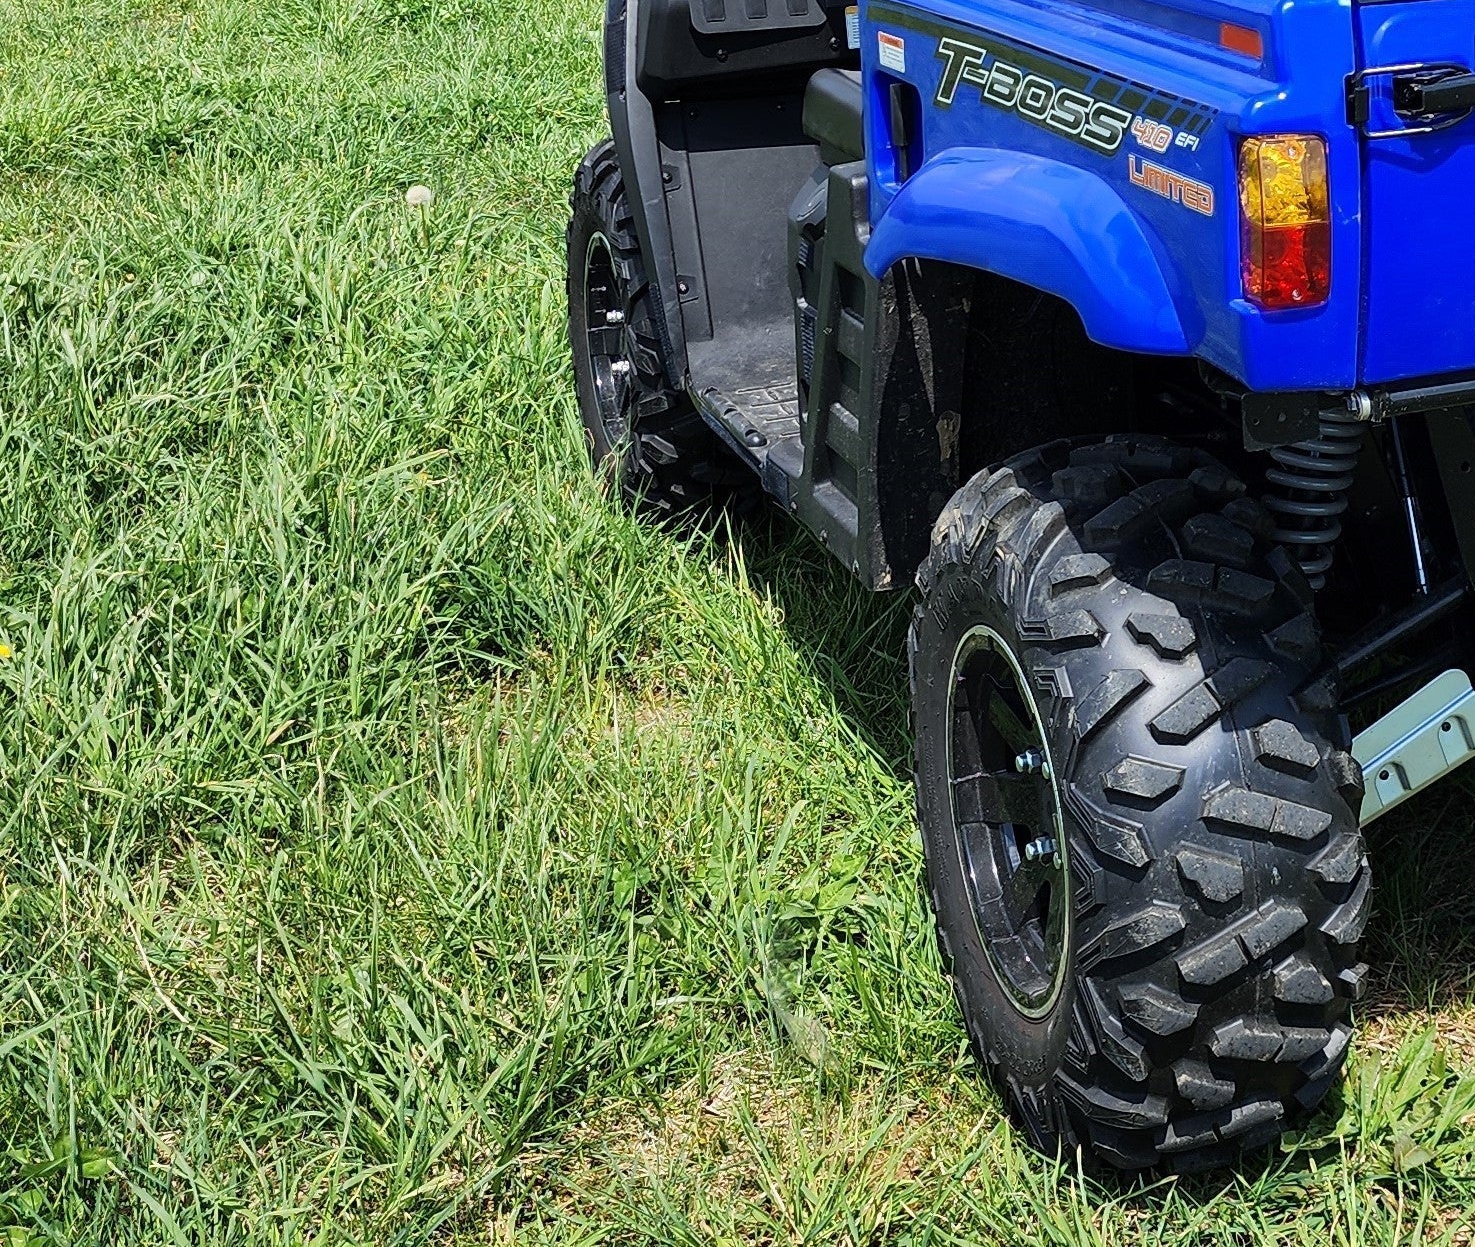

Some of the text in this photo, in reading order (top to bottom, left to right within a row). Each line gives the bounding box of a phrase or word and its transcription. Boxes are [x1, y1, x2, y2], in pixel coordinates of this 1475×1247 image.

[936, 37, 1133, 151] T-BOSS
[1132, 115, 1174, 154] 410
[1175, 131, 1199, 152] EFI
[1128, 154, 1215, 217] LIMITED
